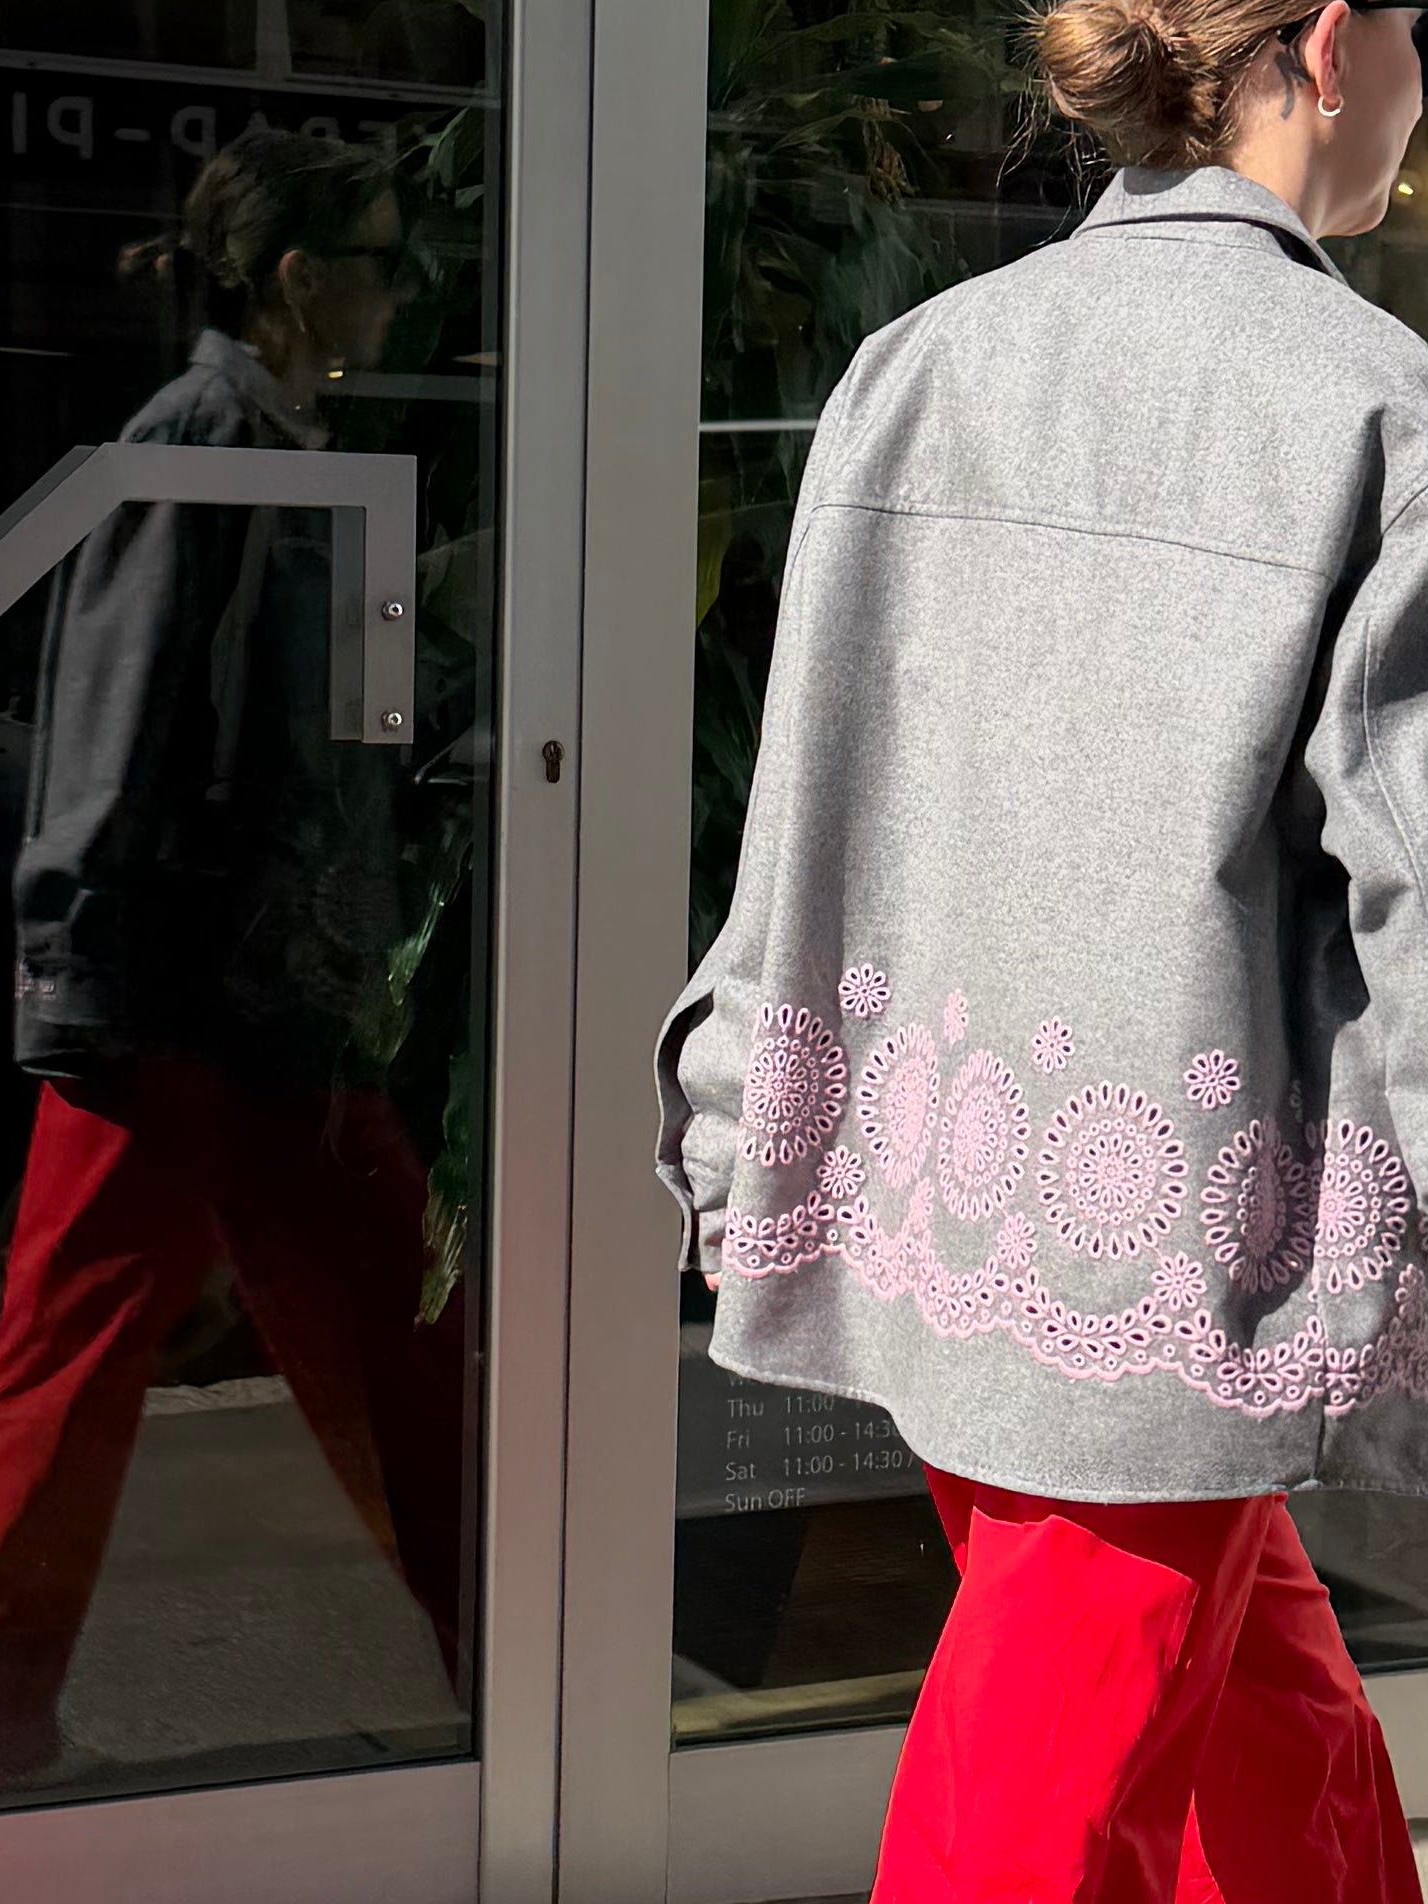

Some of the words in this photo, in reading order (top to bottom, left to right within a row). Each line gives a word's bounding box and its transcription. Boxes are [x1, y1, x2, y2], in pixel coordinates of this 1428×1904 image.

[727, 1399, 764, 1418] Thu
[786, 1395, 835, 1414] 11:00
[726, 1429, 751, 1449] Fri
[784, 1424, 835, 1447] 11:00
[725, 1462, 756, 1481] Sat
[783, 1455, 834, 1477] 11:00
[853, 1450, 903, 1471] 14:30
[724, 1493, 762, 1513] Sun
[767, 1487, 806, 1509] OFF
